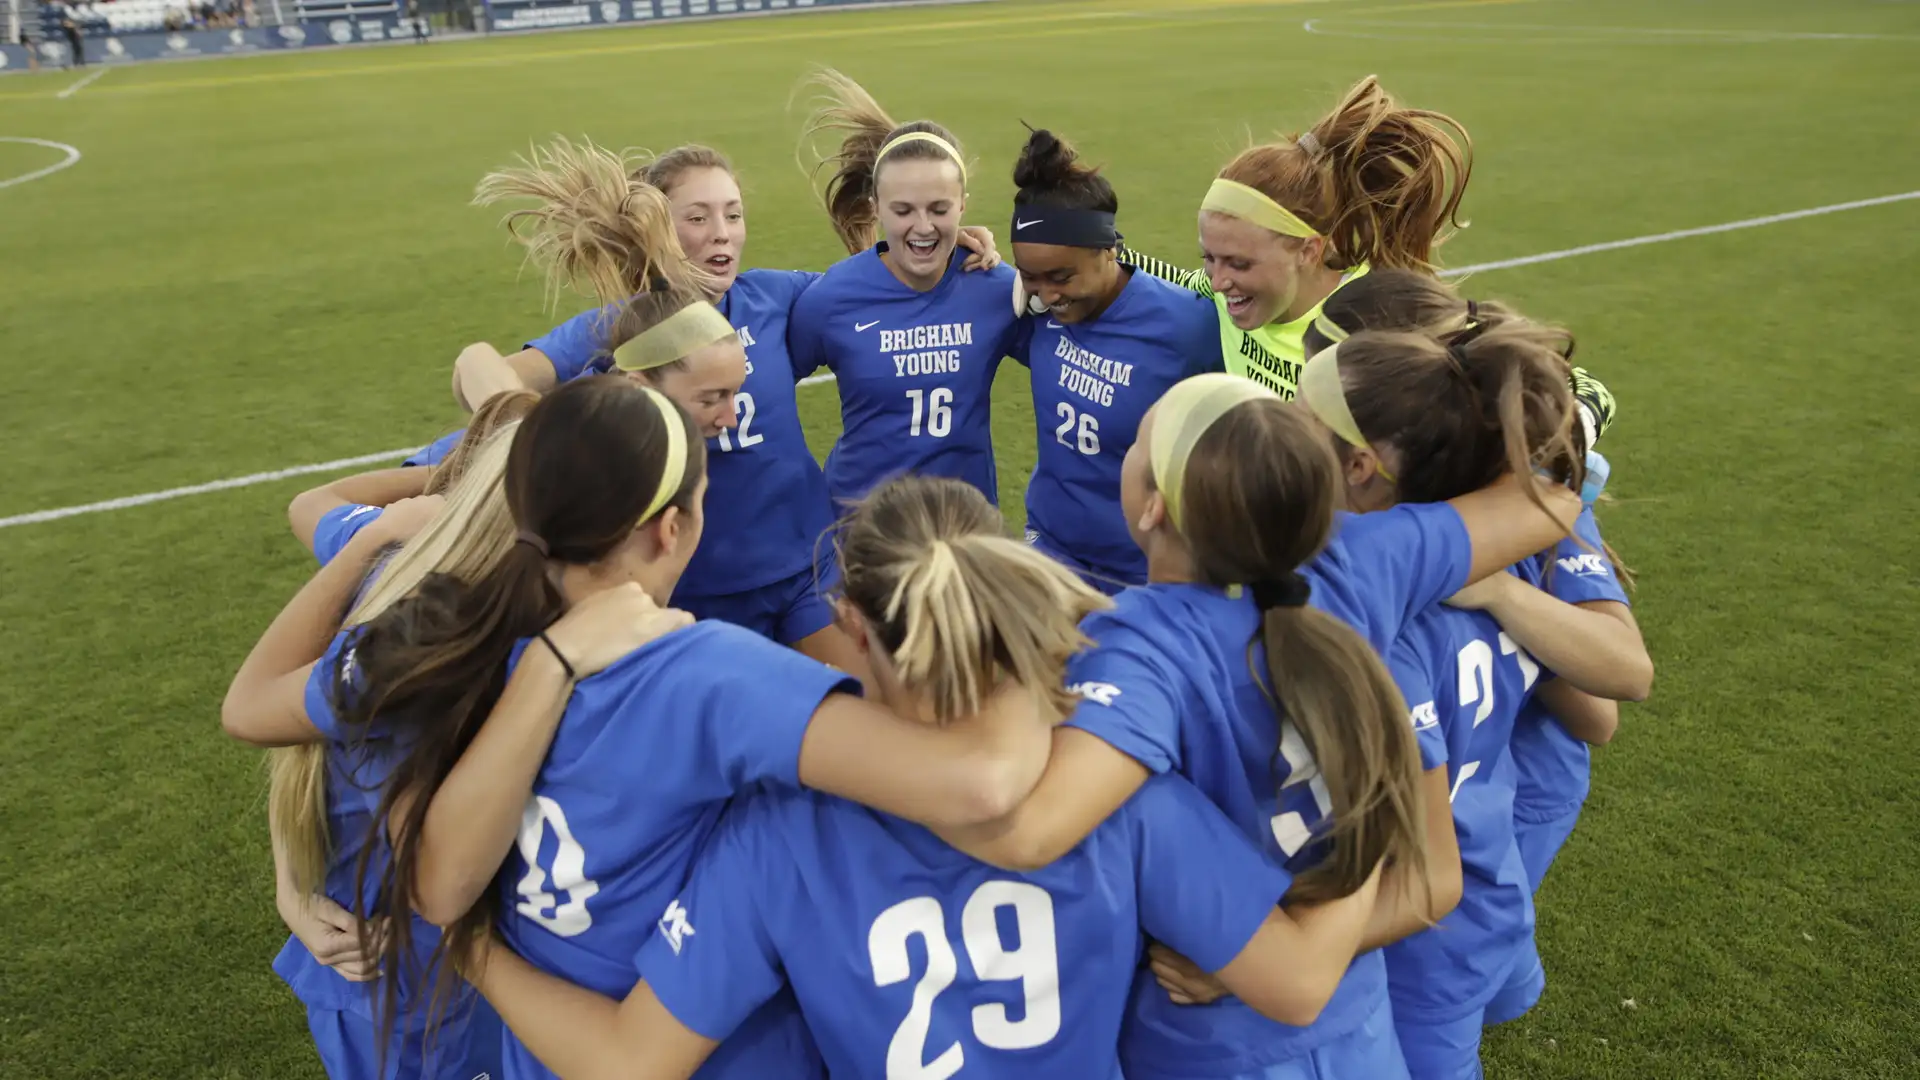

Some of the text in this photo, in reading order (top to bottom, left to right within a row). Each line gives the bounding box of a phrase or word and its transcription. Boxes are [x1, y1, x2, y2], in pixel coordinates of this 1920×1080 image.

[880, 322, 972, 352] BRIGHAM
[1054, 335, 1133, 387] BRIGHAM
[893, 350, 960, 377] YOUNG
[1058, 363, 1115, 407] YOUNG
[905, 387, 953, 438] 16
[1055, 402, 1100, 455] 26
[868, 880, 1061, 1080] 29
